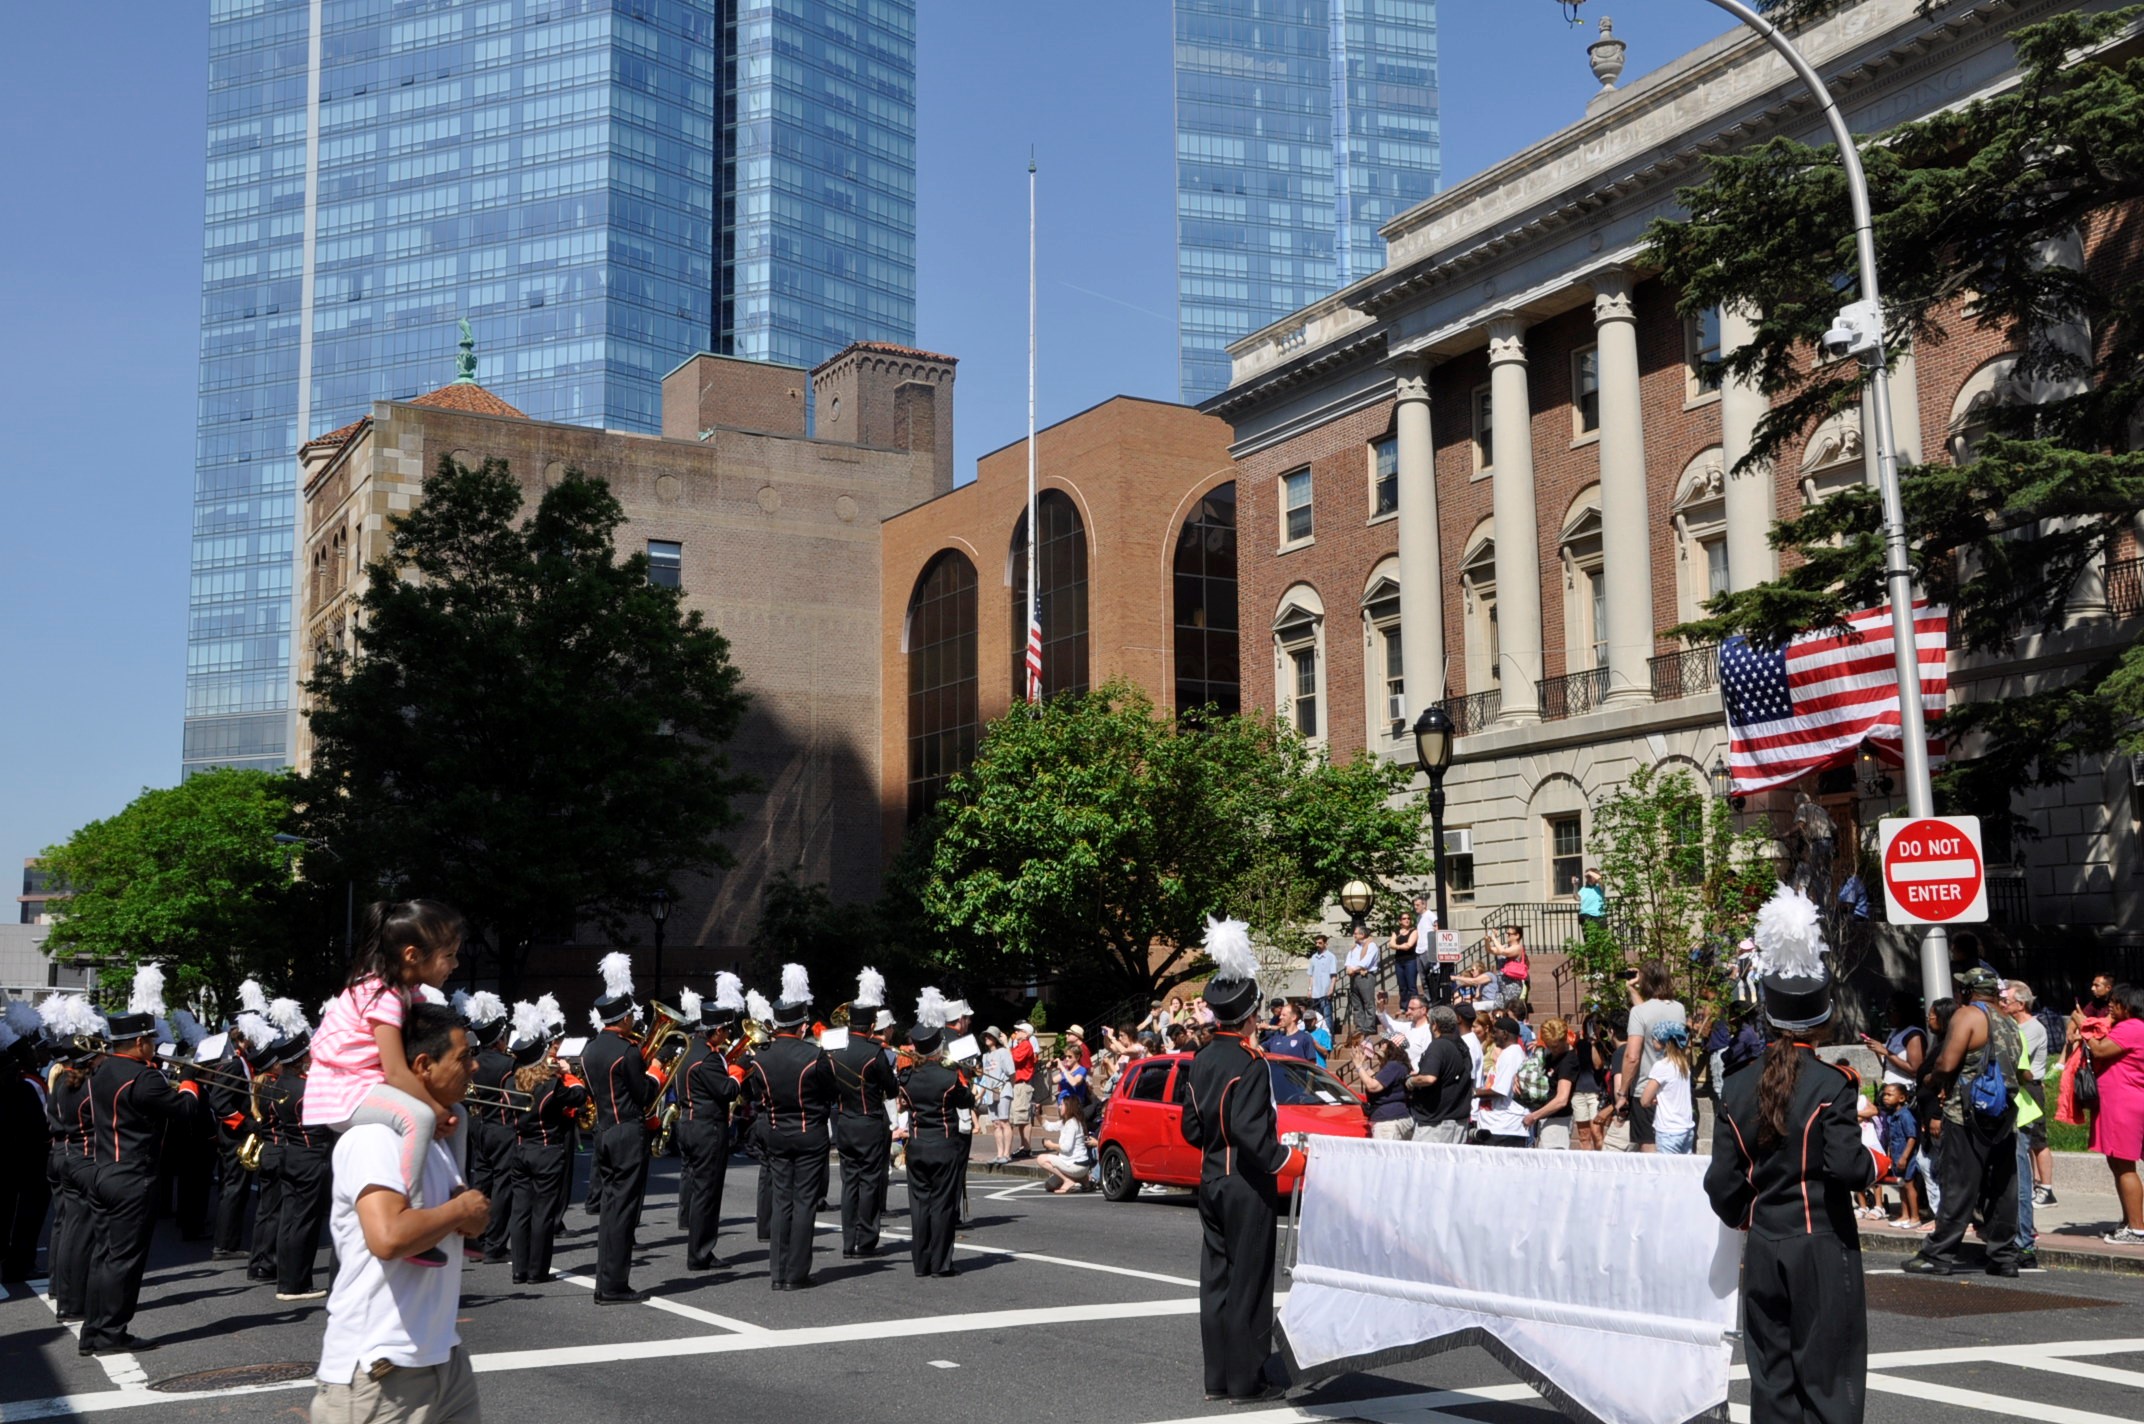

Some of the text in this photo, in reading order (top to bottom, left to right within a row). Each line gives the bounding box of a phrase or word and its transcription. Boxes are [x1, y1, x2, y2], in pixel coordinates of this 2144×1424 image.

[1899, 838, 1960, 857] DO NOT
[1908, 884, 1961, 902] ENTER
[1442, 933, 1453, 942] NO
